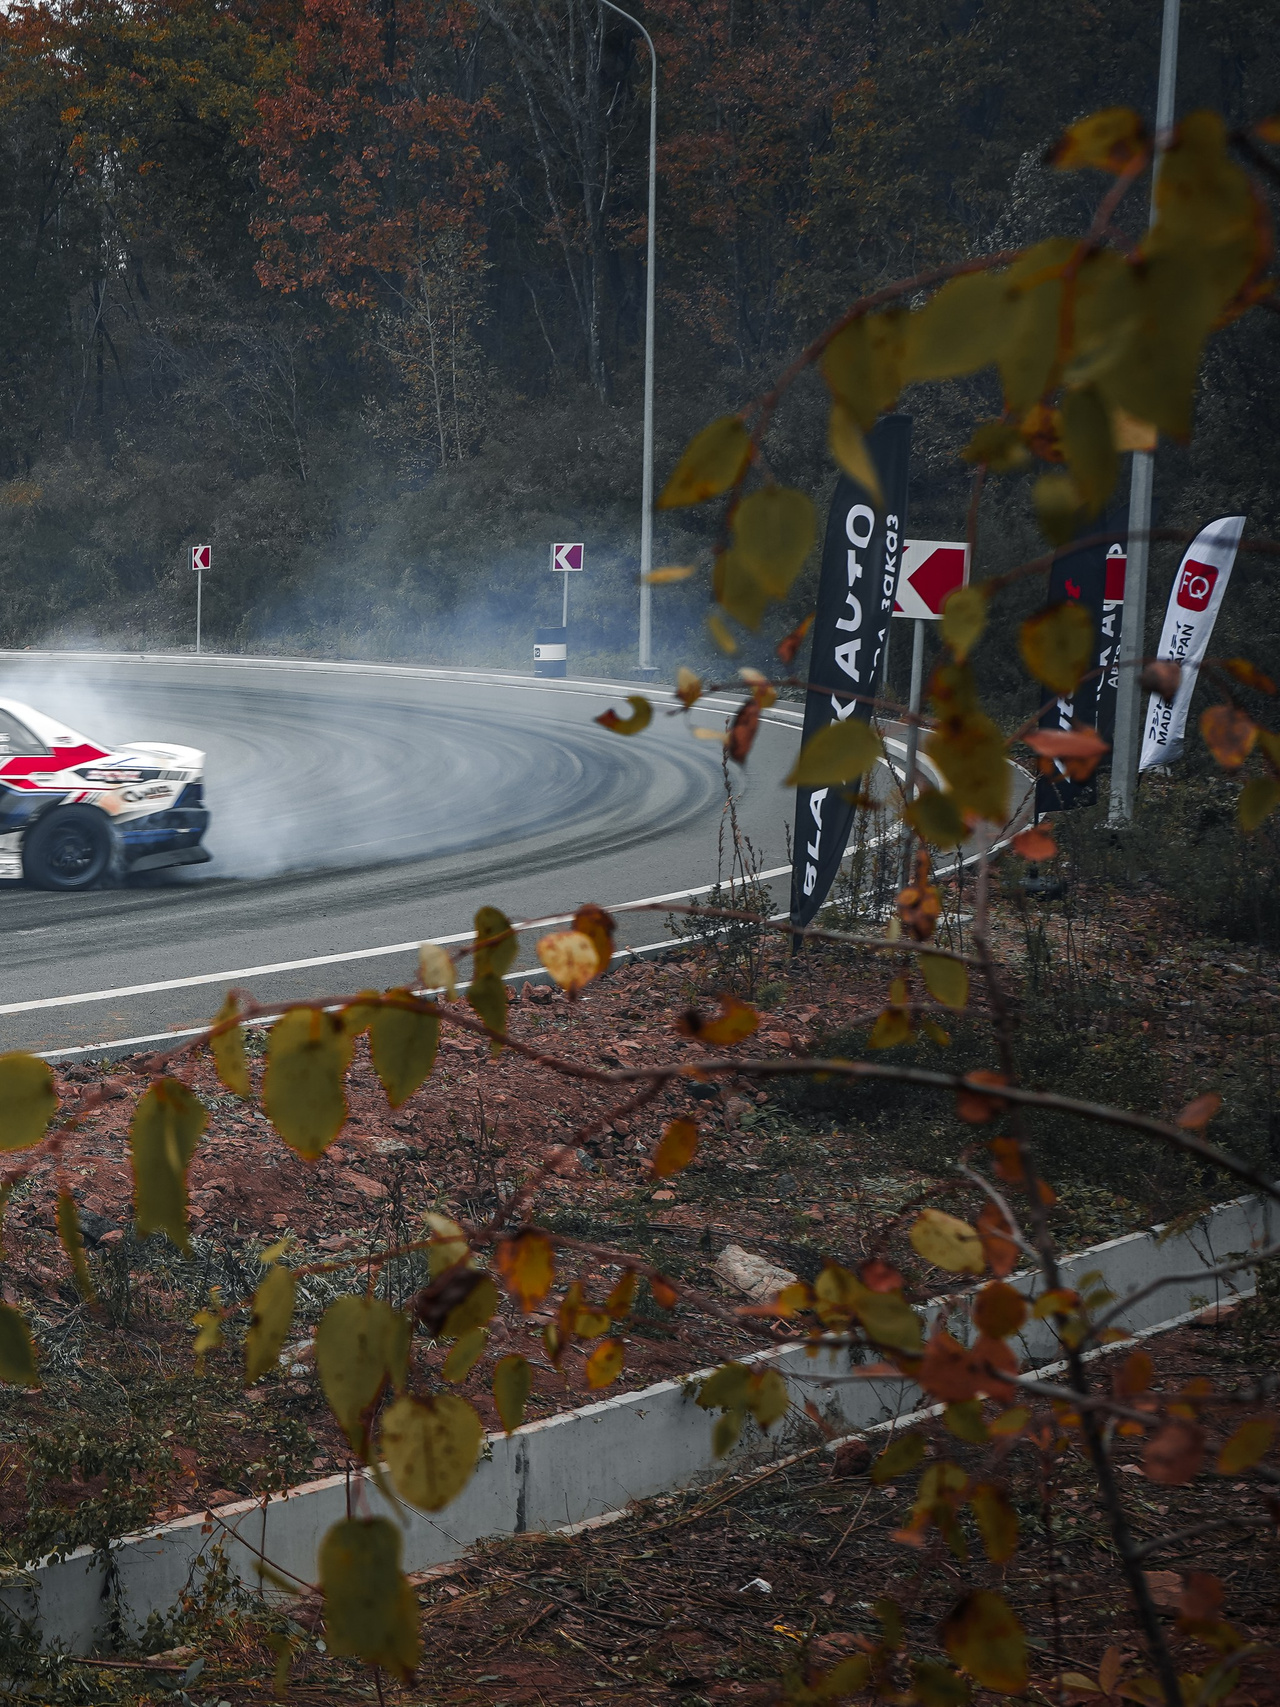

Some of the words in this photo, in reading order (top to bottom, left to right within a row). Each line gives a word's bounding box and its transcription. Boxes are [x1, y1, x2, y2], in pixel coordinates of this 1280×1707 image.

[880, 513, 899, 613] заказ
[1179, 570, 1211, 601] FQ
[1173, 623, 1195, 664] APAN
[803, 692, 858, 897] BLAK
[834, 503, 876, 683] AUTO
